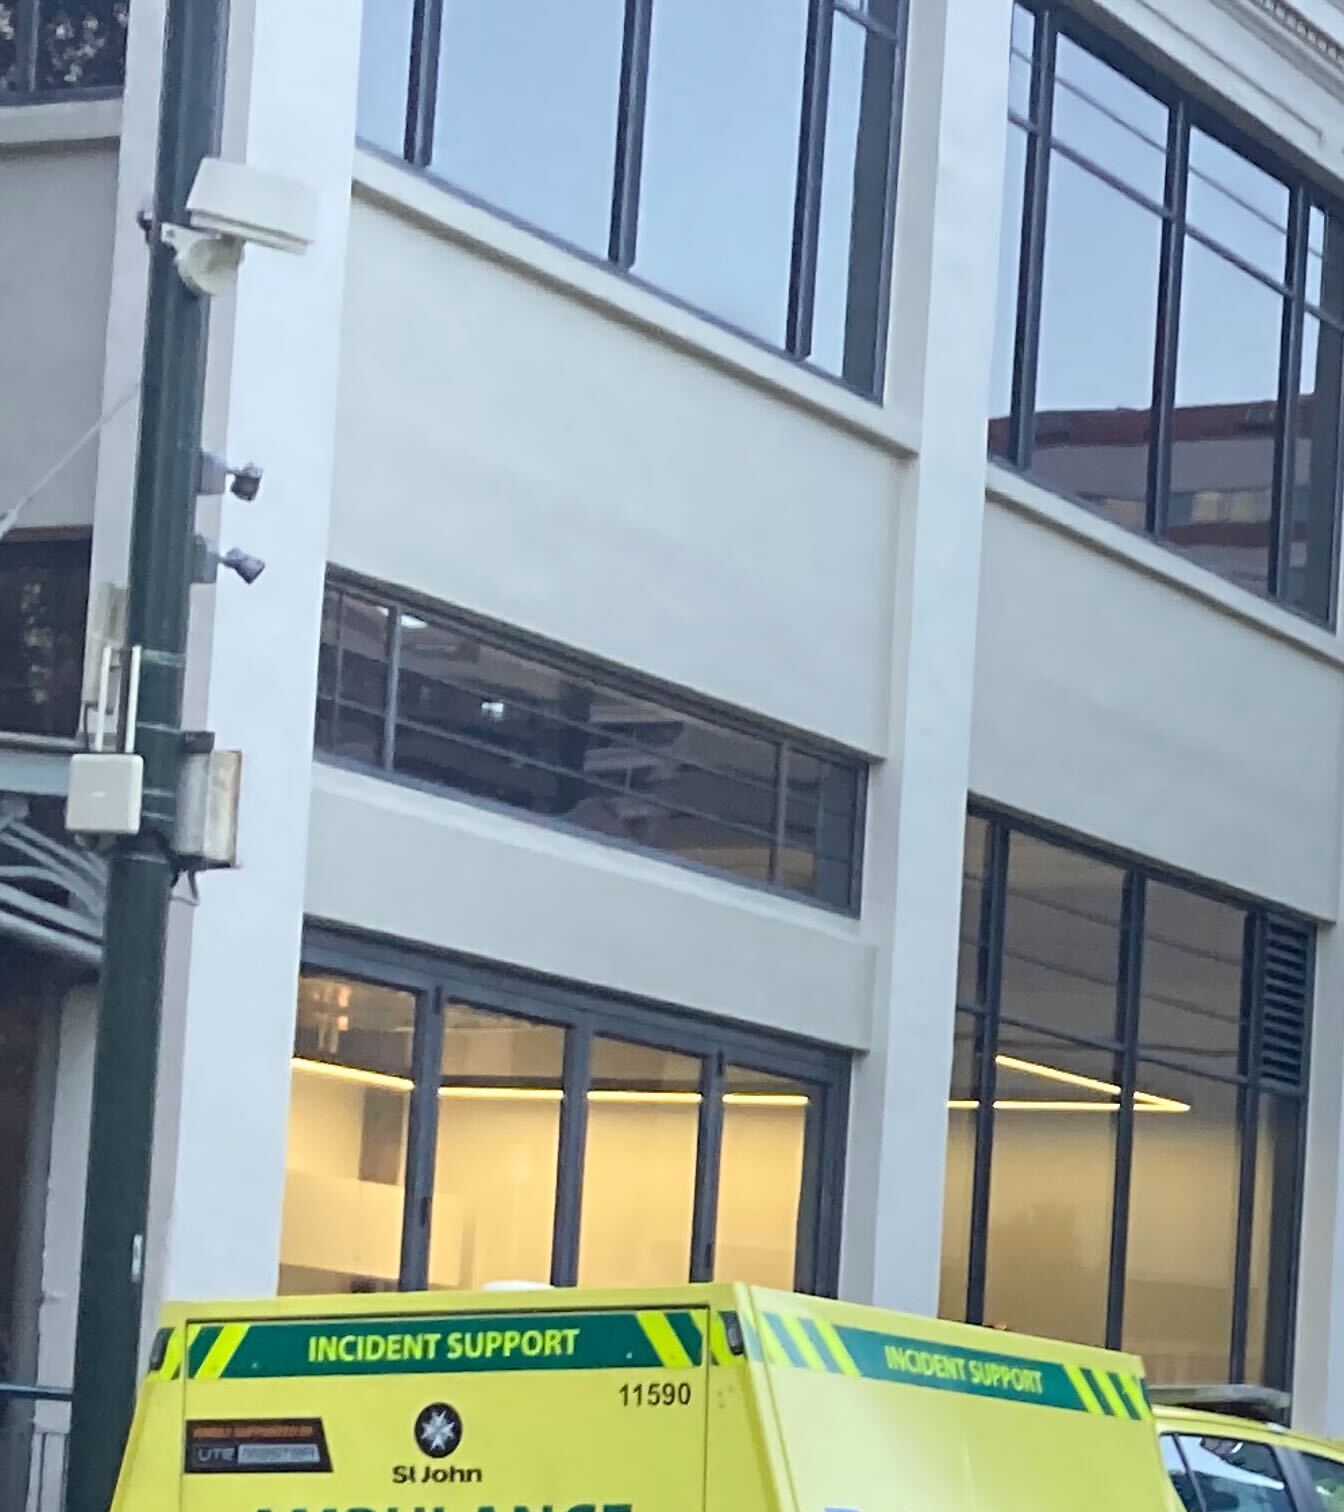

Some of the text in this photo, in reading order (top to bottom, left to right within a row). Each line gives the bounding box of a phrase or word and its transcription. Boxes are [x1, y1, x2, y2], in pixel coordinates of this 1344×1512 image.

[308, 1328, 580, 1363] INCIDENT SUPPORT
[885, 1345, 1043, 1394] INCIDENT SUPPORT
[619, 1382, 692, 1408] 11590
[392, 1465, 482, 1484] St John
